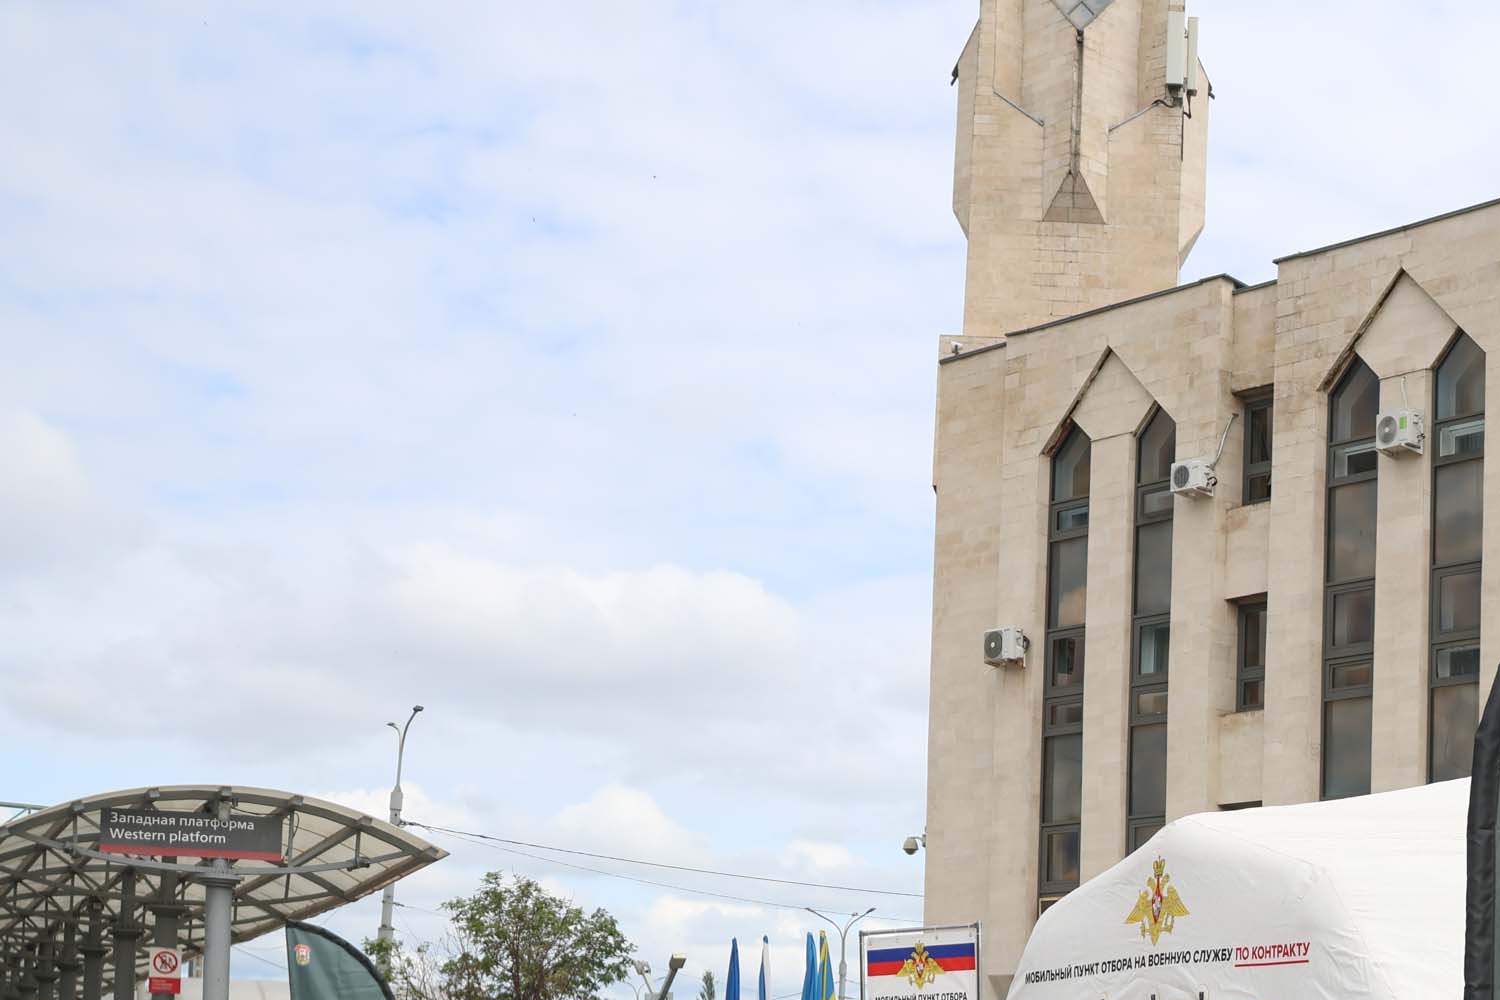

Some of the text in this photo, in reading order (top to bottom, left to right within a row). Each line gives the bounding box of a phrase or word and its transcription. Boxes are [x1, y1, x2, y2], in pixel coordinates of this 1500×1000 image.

[110, 812, 254, 830] Западная платформа
[109, 828, 226, 844] Western platform
[1025, 942, 1310, 984] МОБИЛЬНЫЙ ПУНКТ ОТБОРА НА ВОЕННУЮ СЛУЖБУ ПО КОНТРАКТУ
